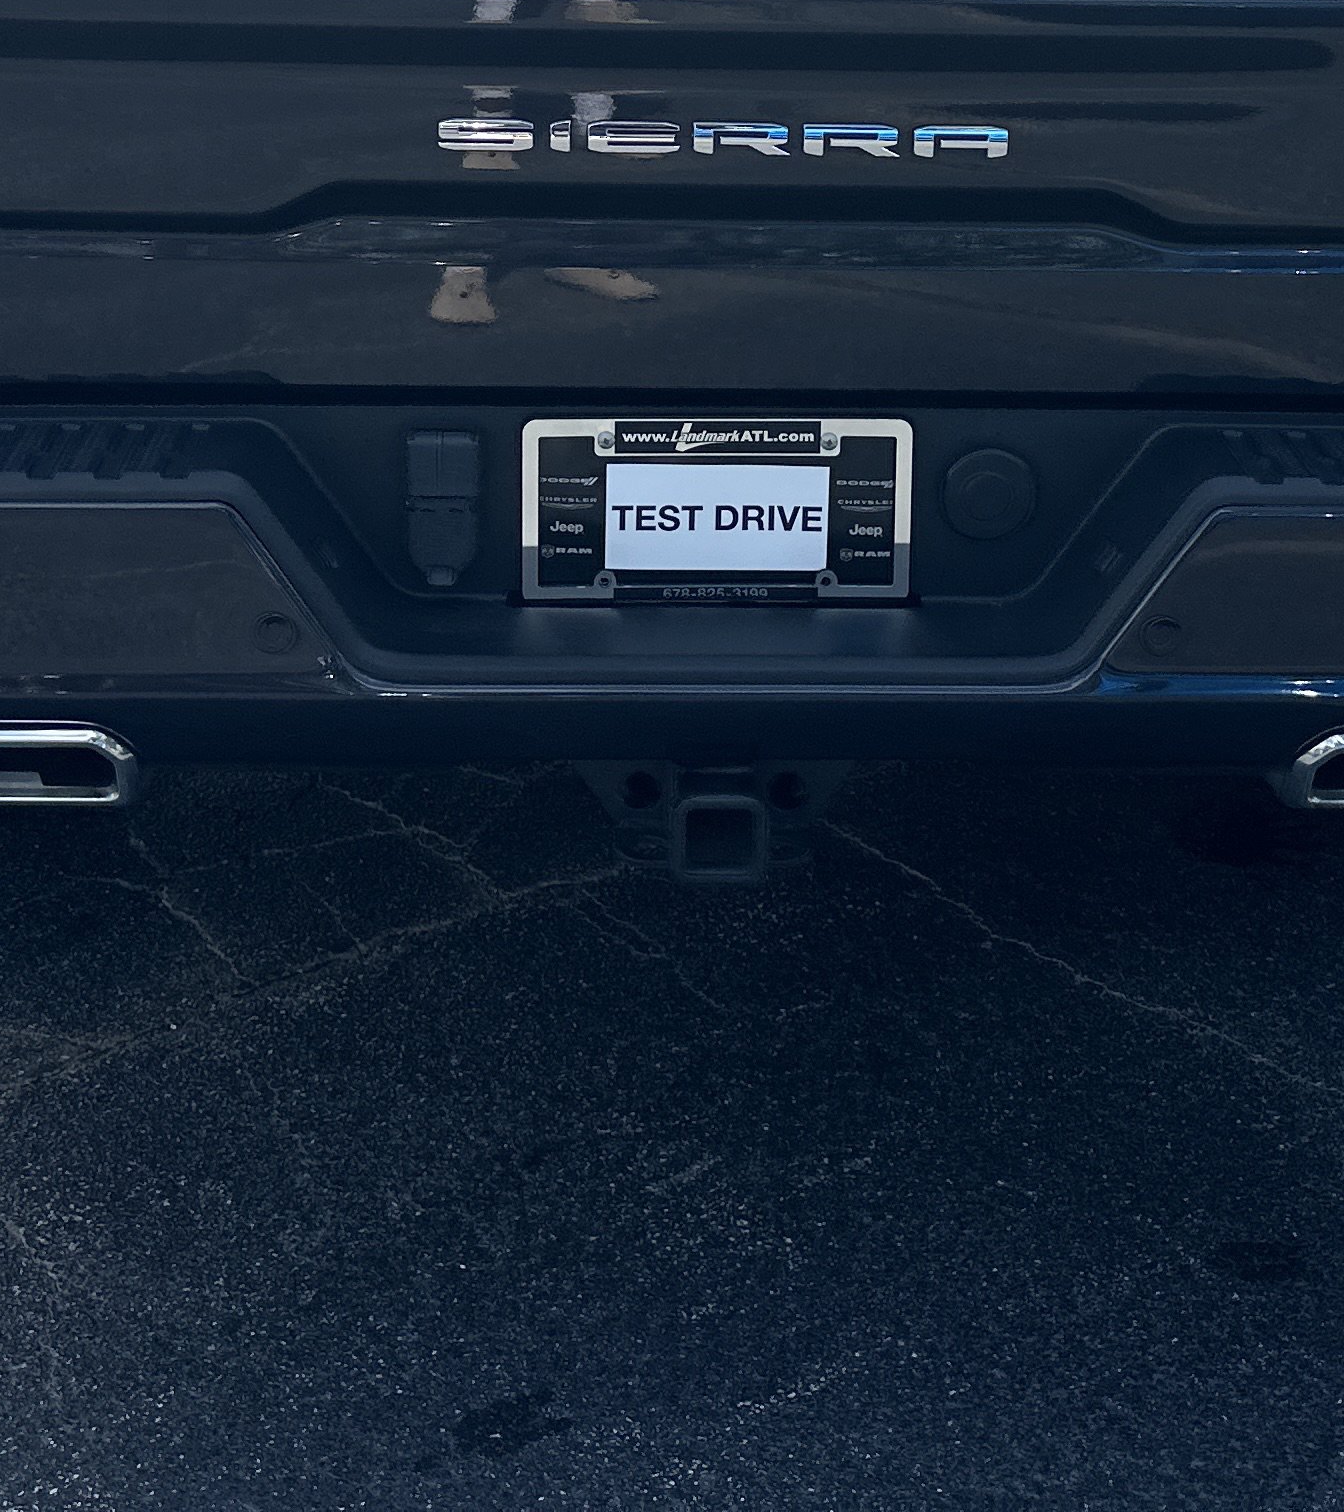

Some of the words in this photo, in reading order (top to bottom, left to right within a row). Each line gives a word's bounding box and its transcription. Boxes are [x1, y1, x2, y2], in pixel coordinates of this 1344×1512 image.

[437, 118, 1010, 158] SIERRA
[621, 422, 815, 452] www.LandmarkATL.com
[611, 504, 704, 532] TEST
[714, 505, 824, 533] DRIVE
[549, 520, 584, 535] Jeep
[848, 523, 883, 538] Jeep
[555, 547, 593, 555] RAM
[853, 550, 891, 558] RAM
